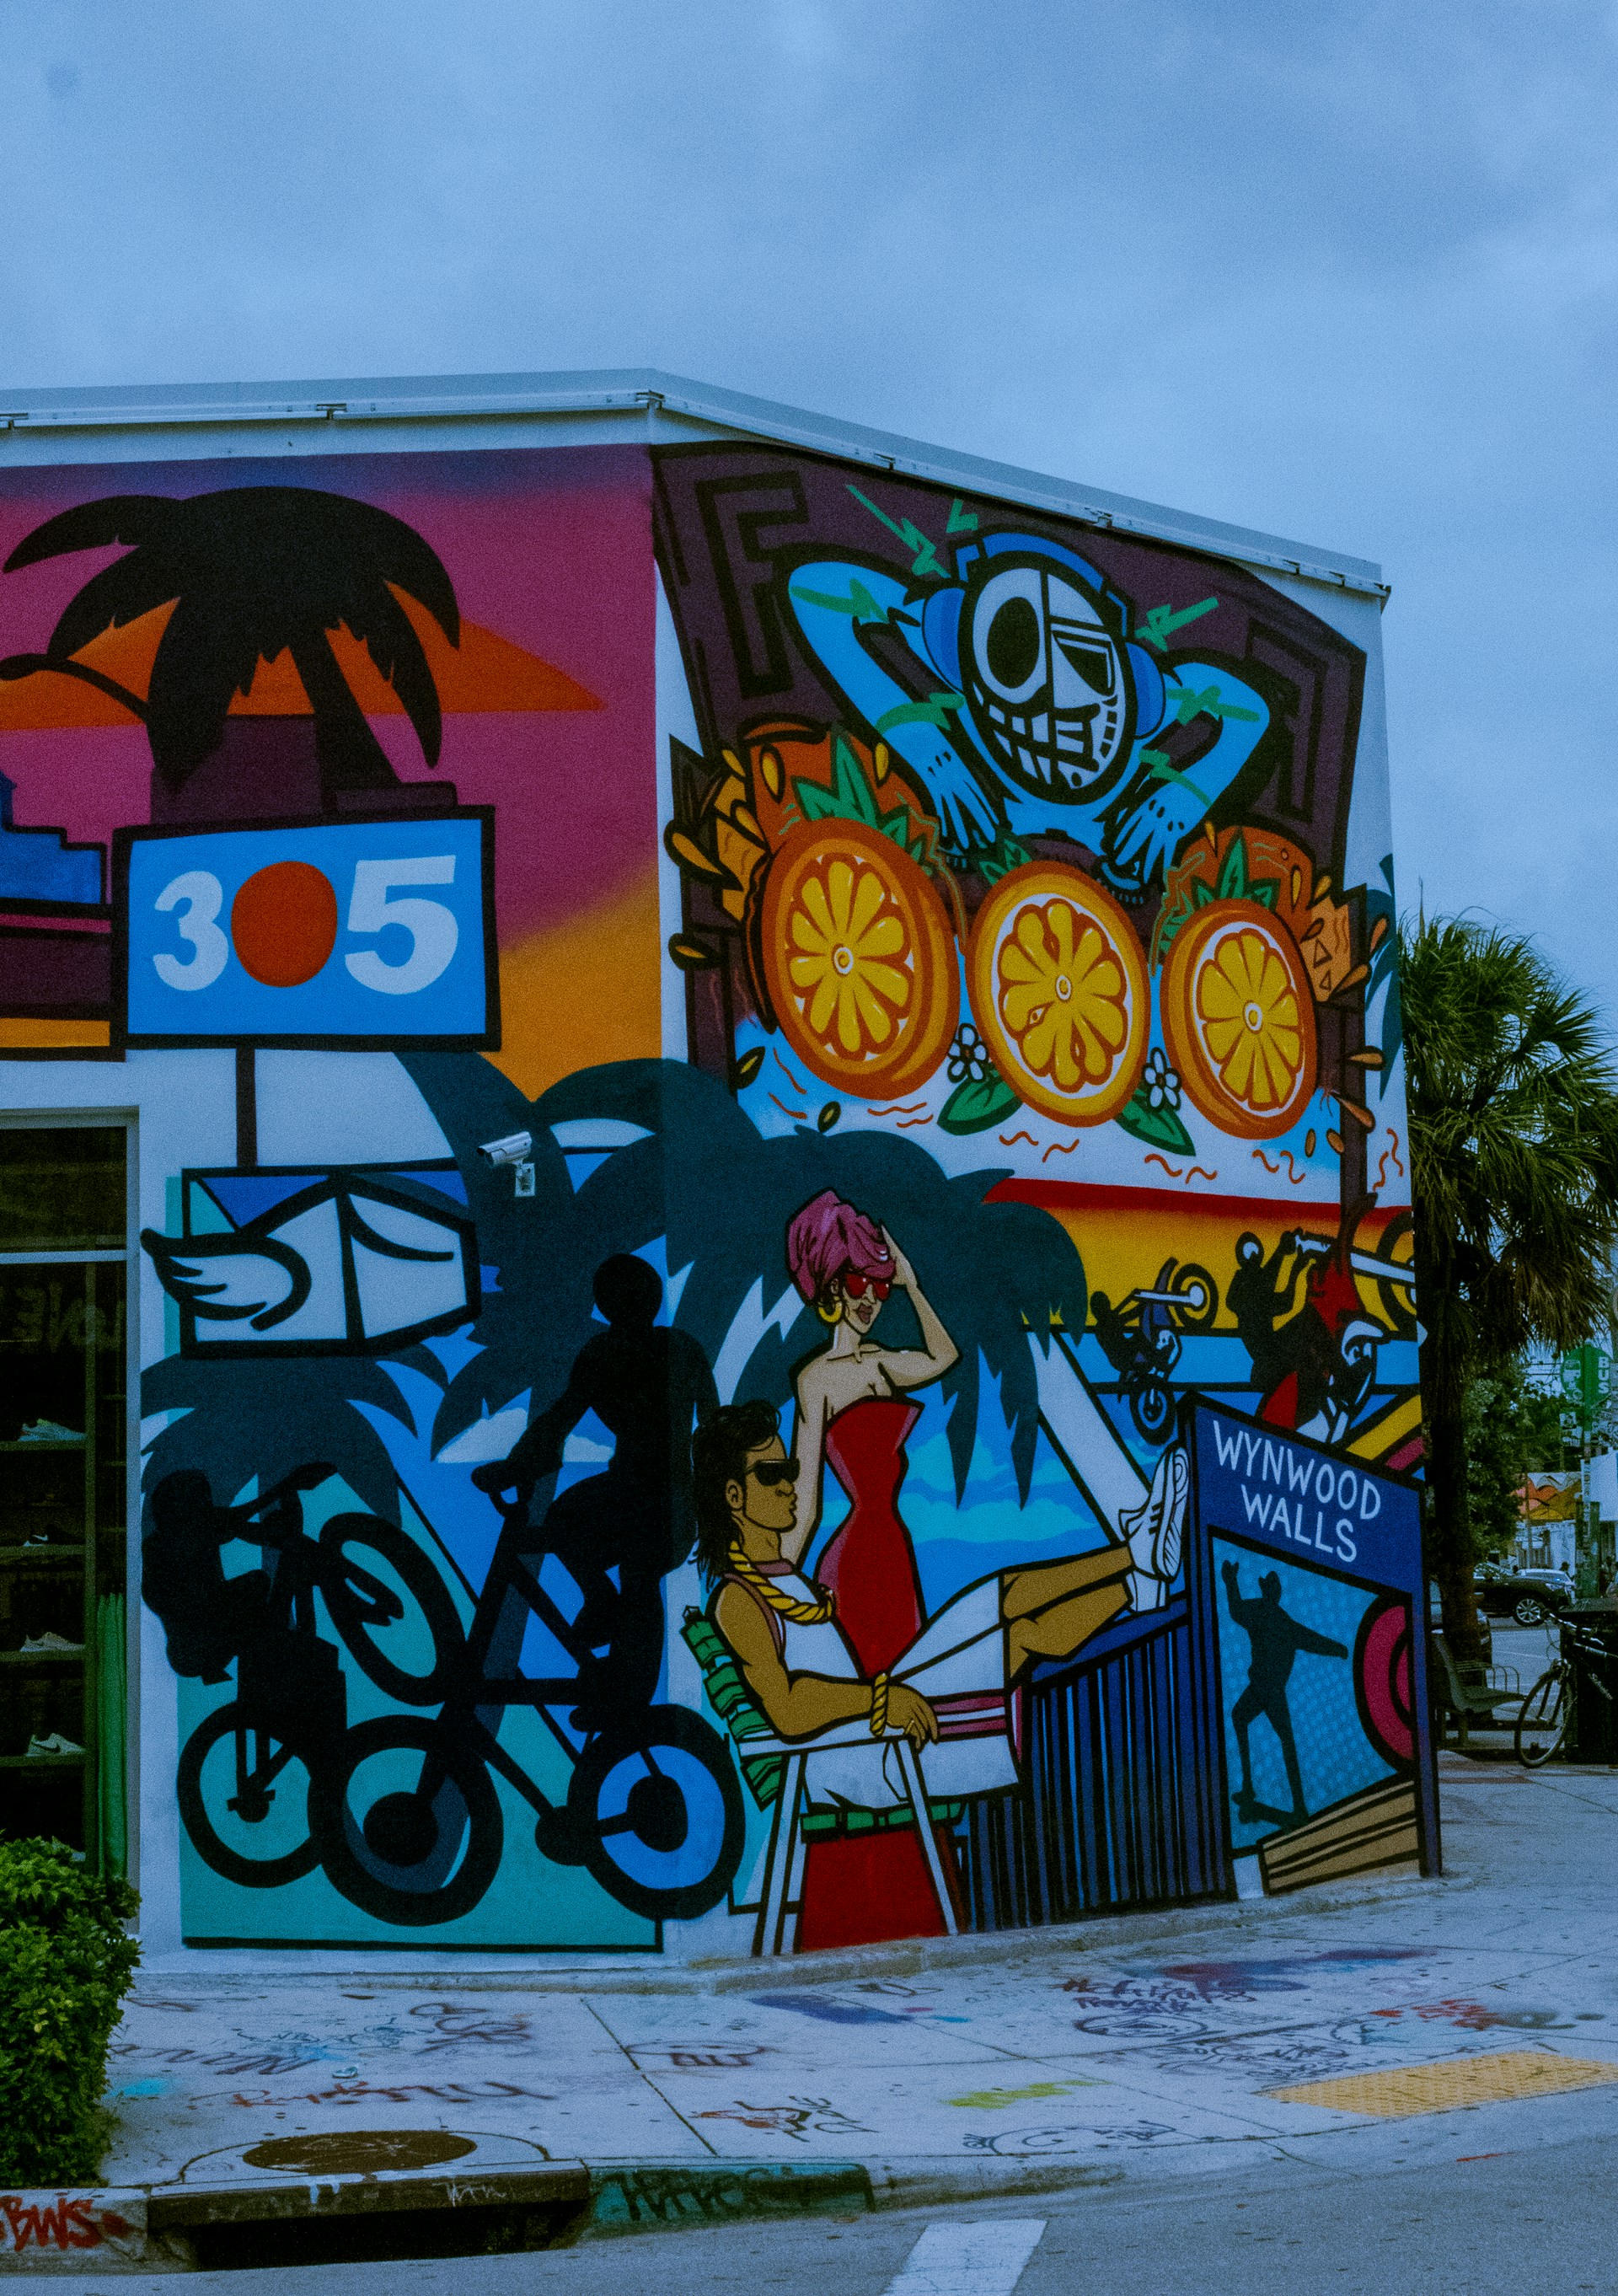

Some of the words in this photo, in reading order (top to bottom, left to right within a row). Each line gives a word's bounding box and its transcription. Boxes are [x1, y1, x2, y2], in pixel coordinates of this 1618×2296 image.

[153, 855, 459, 995] 305
[1598, 1356, 1610, 1394] BUS
[1214, 1419, 1381, 1520] WYNWOOD
[1241, 1483, 1357, 1562] WALLS
